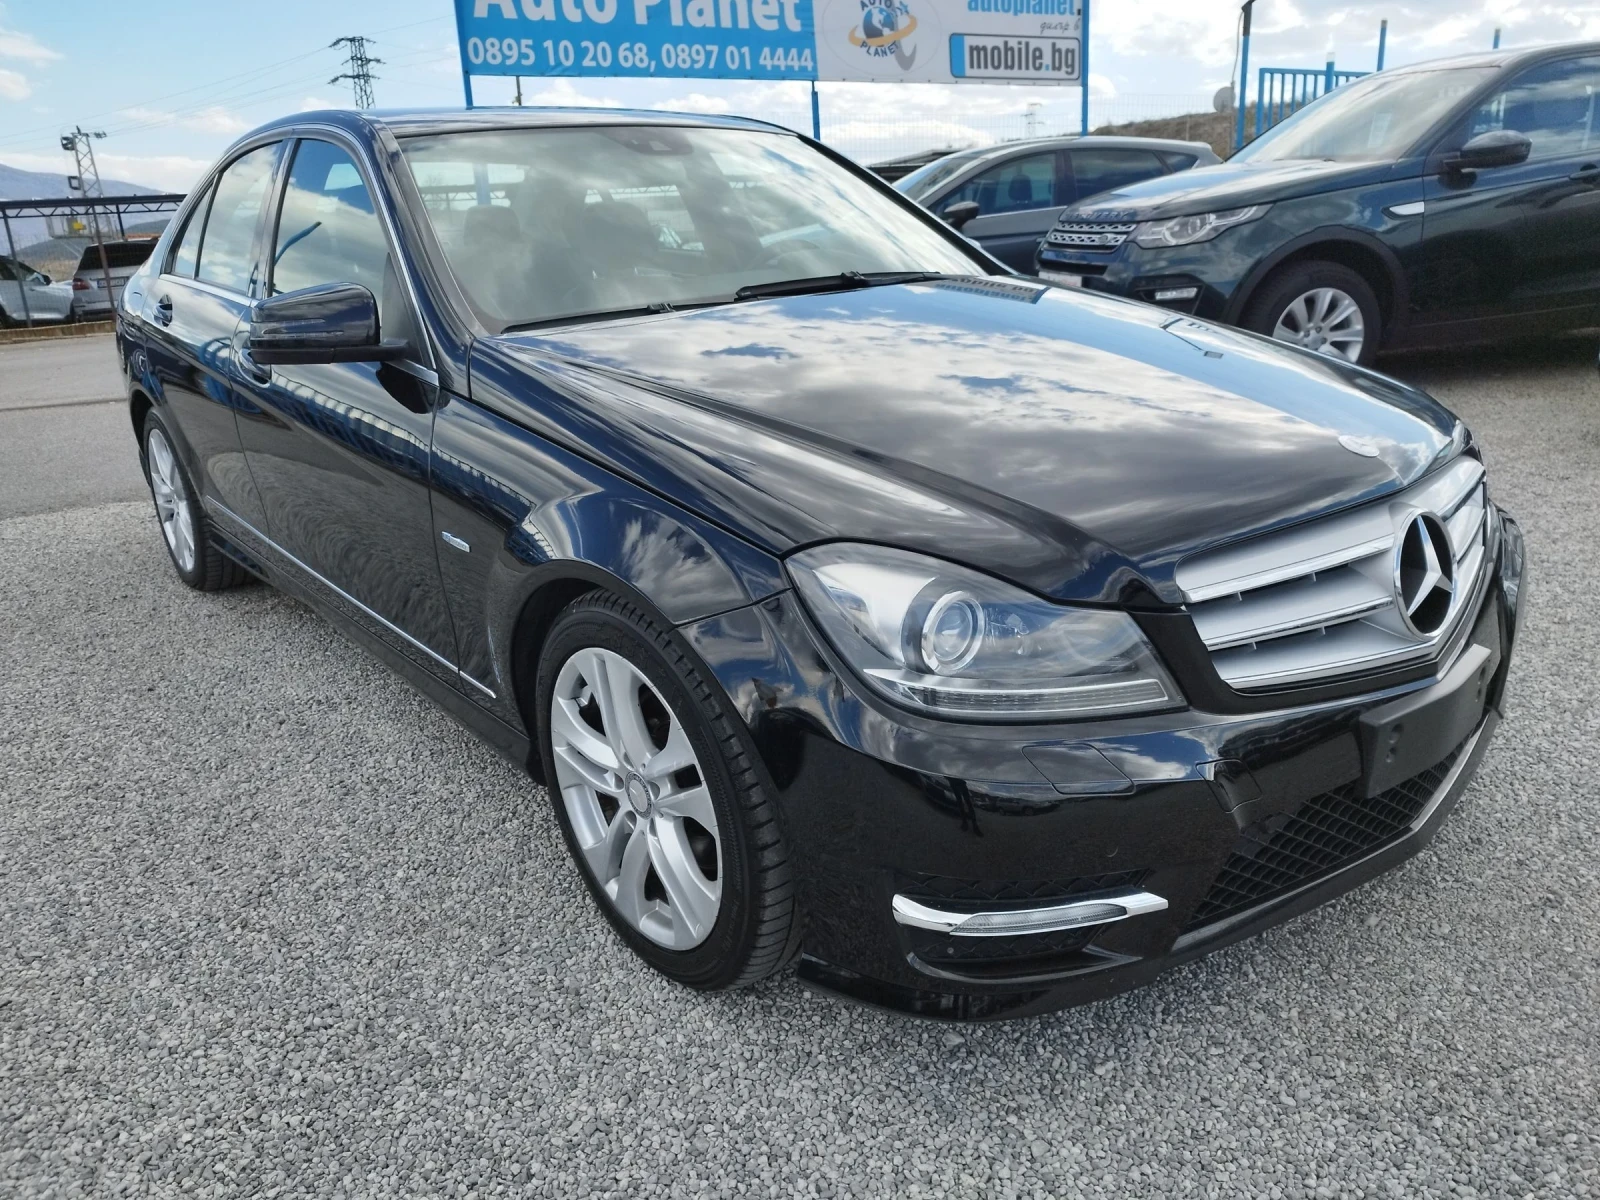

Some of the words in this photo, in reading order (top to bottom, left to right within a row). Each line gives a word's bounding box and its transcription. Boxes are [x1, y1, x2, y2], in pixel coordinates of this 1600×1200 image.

[634, 0, 801, 32] Planet
[467, 37, 536, 65] 0895
[543, 40, 575, 67] 10
[580, 41, 612, 67] 20
[618, 42, 656, 72] 68,
[661, 43, 719, 69] 0897
[725, 45, 751, 70] 01
[759, 47, 814, 71] 4444
[860, 40, 899, 57] PLANET
[969, 40, 1076, 75] mobile.bg
